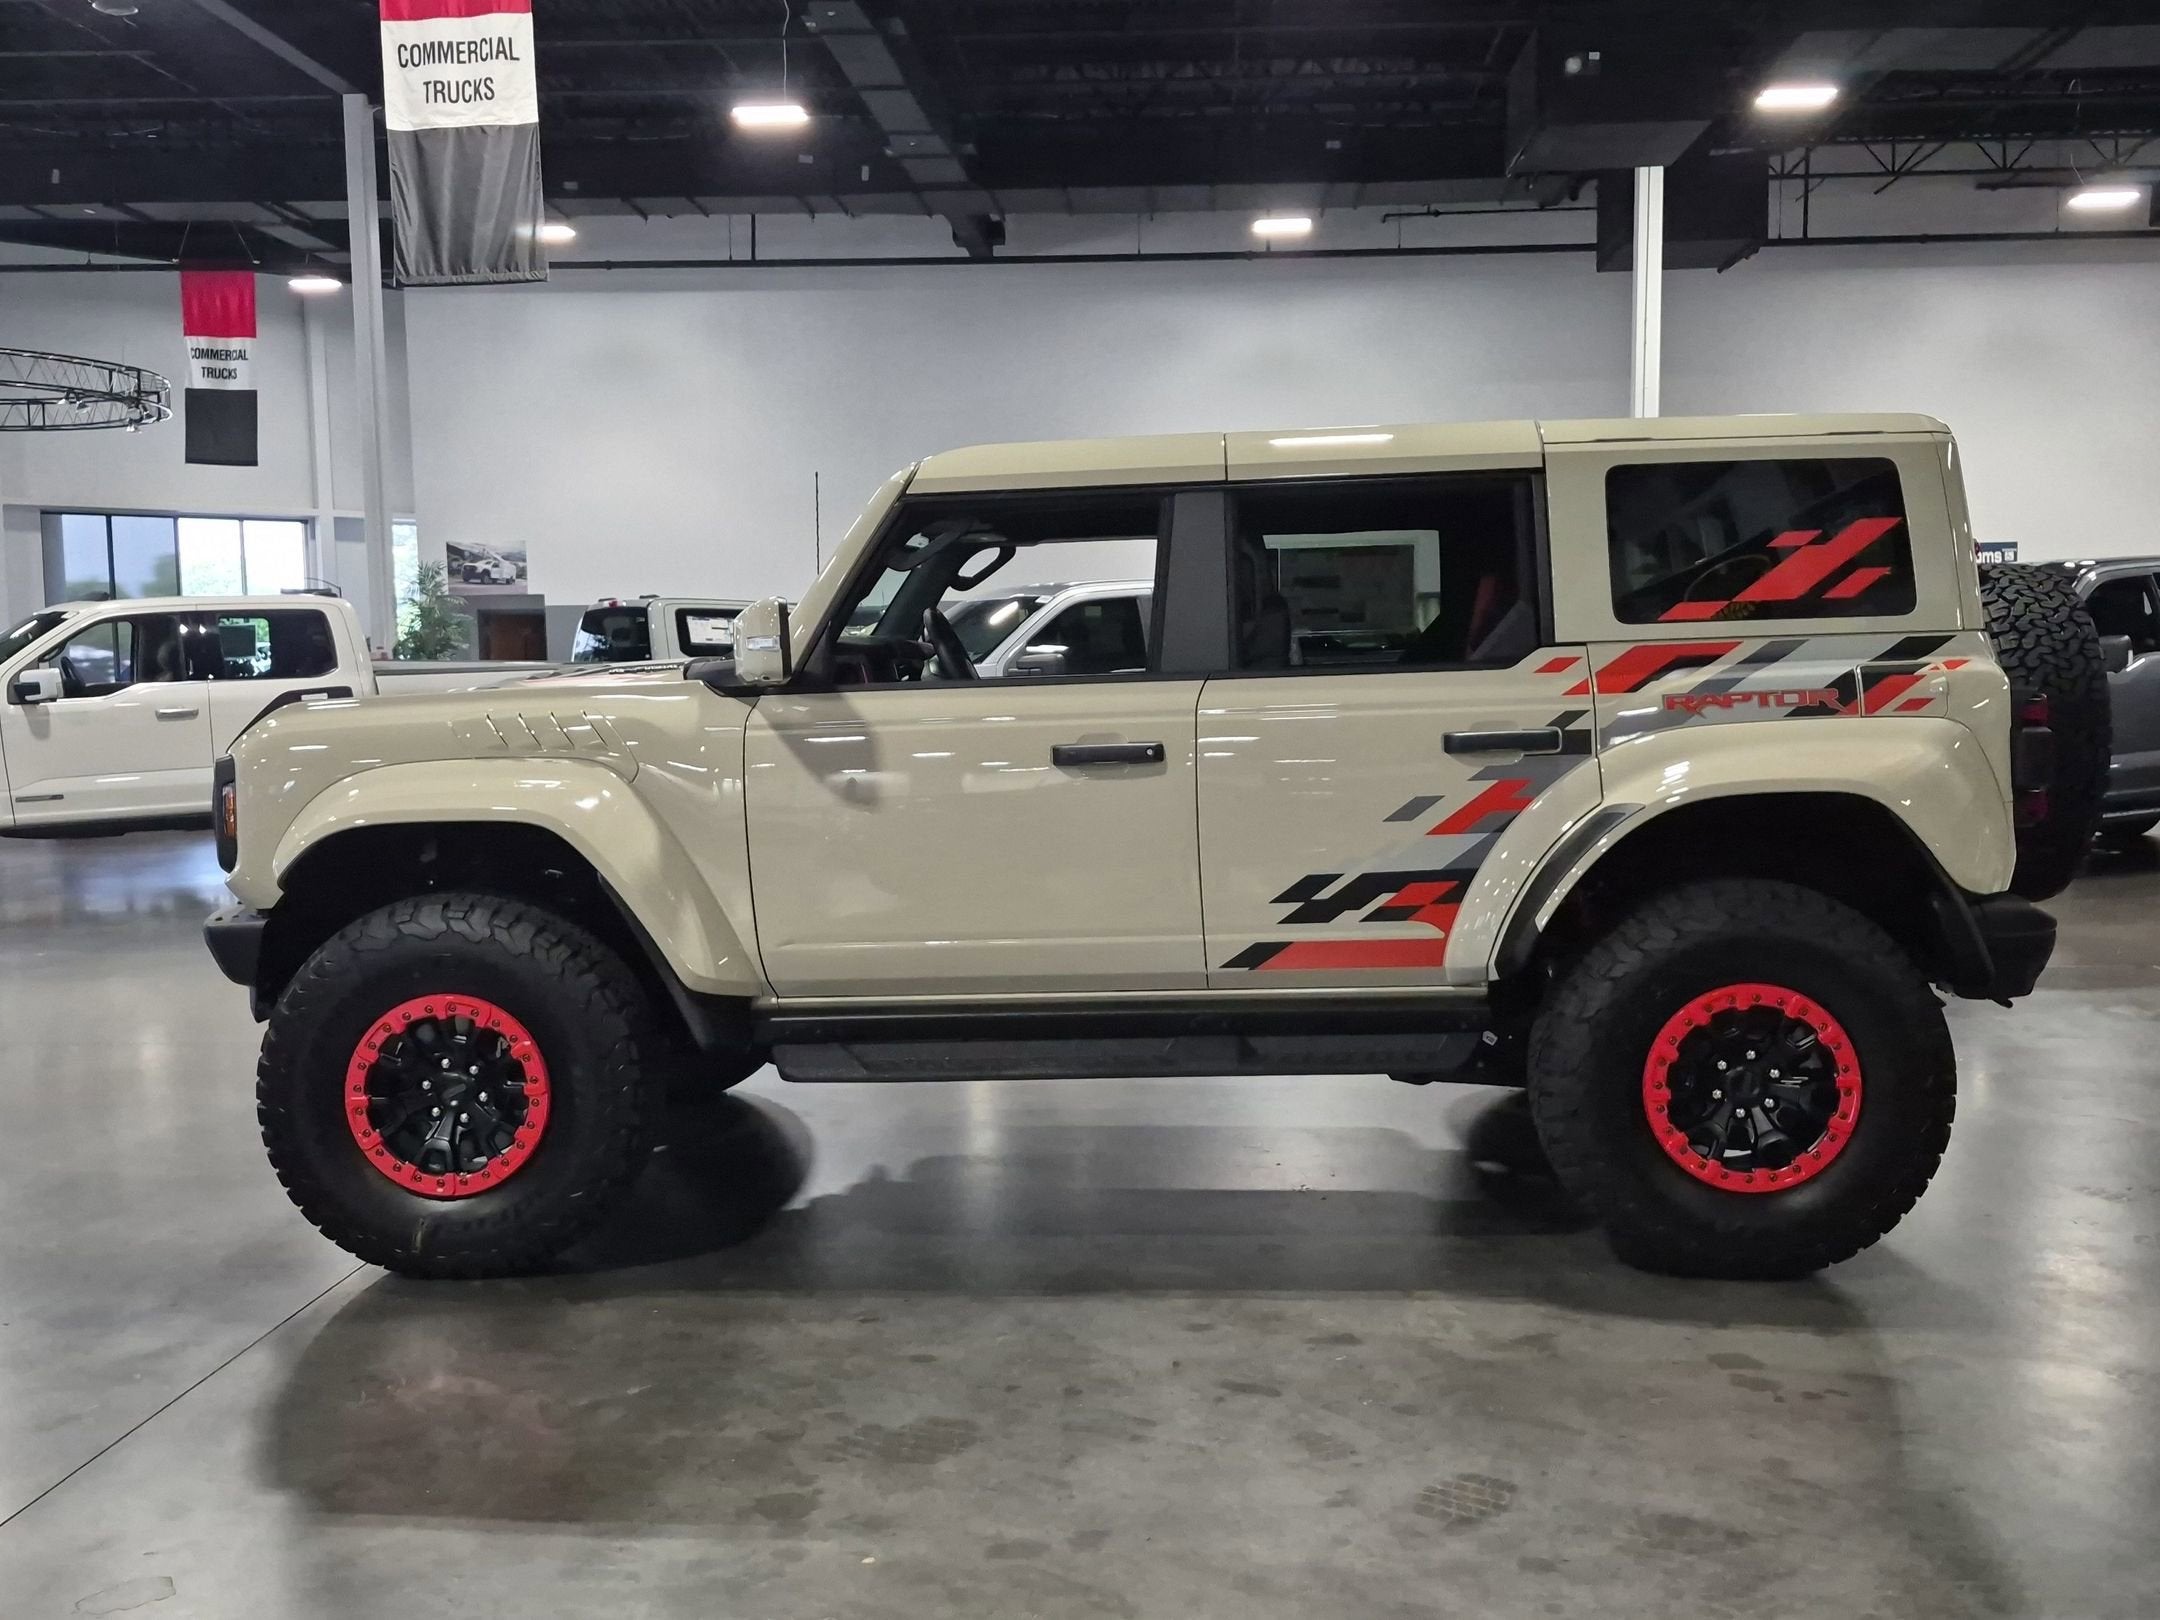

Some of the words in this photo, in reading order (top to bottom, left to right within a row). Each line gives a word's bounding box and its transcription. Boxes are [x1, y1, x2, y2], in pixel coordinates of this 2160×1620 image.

[397, 36, 520, 69] COMMERCIAL
[423, 77, 495, 104] TRUCKS
[190, 347, 249, 361] COMMERCIAL
[201, 366, 238, 380] TRUCKS
[1662, 688, 1849, 719] RAPTOR
